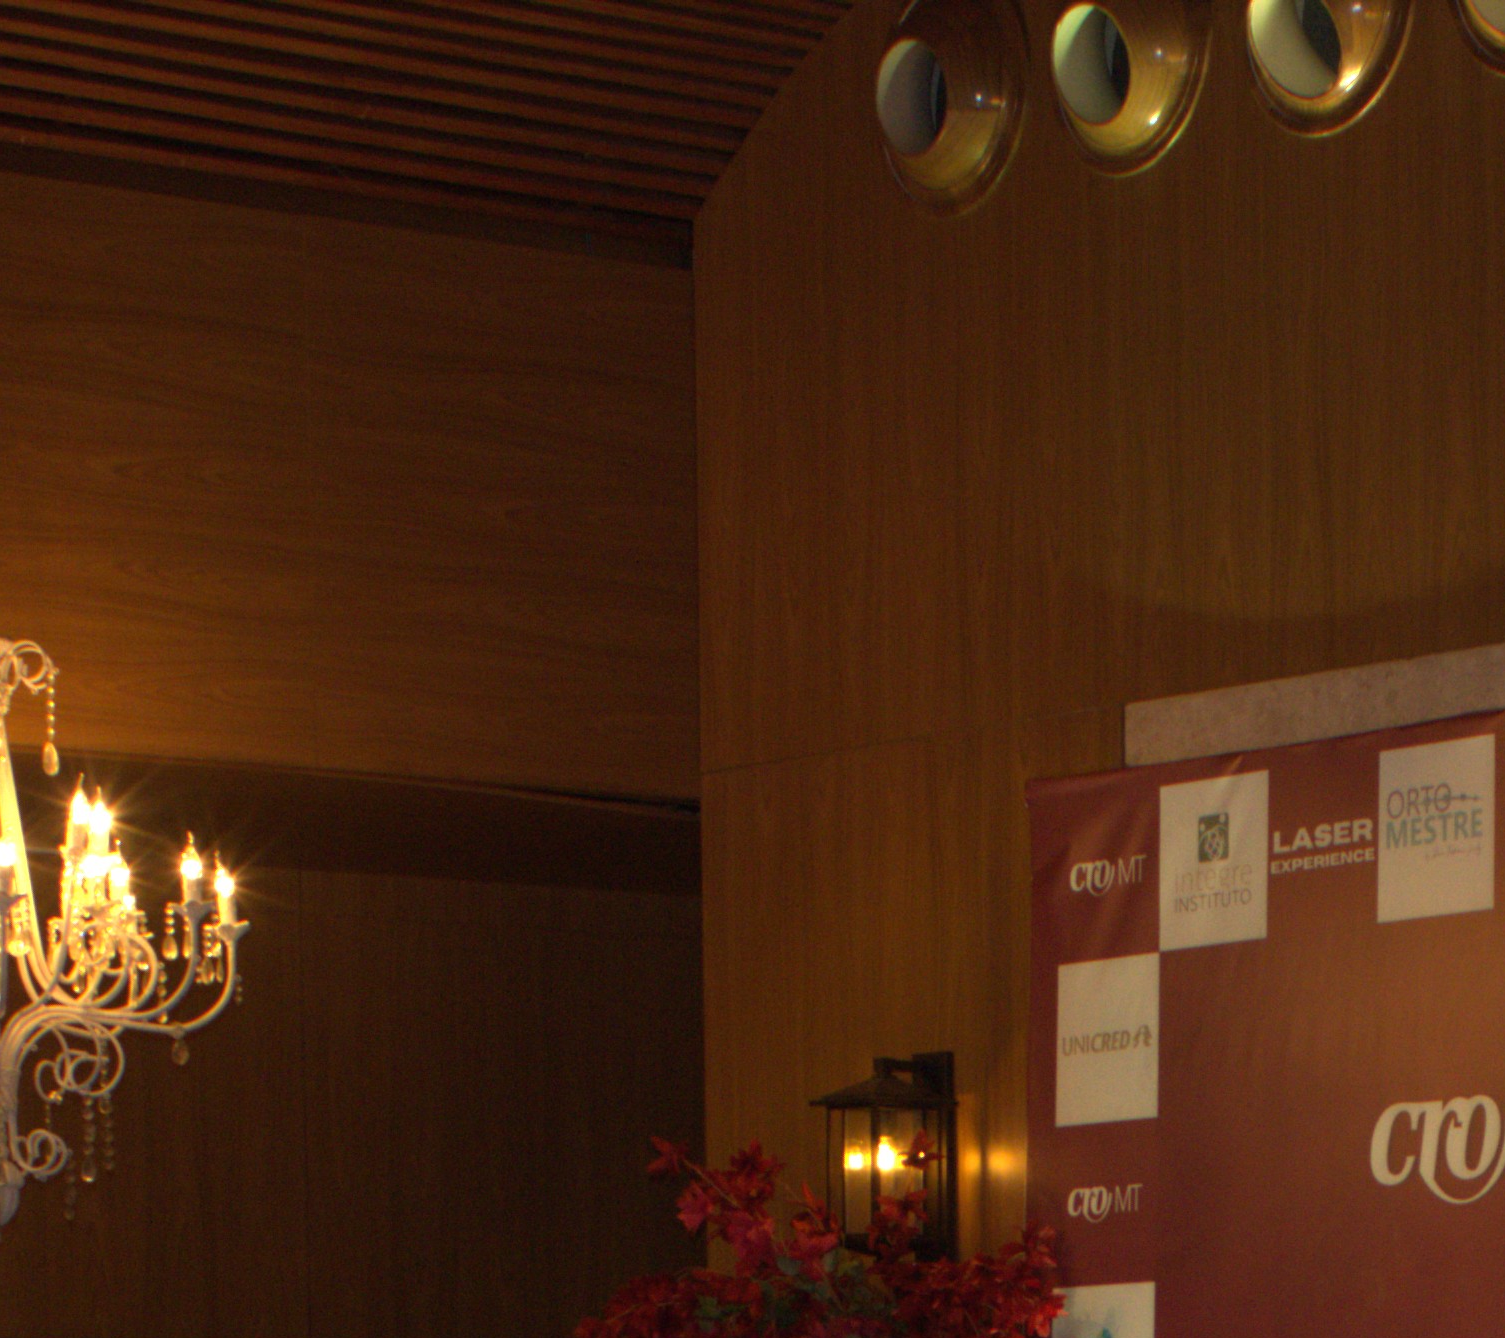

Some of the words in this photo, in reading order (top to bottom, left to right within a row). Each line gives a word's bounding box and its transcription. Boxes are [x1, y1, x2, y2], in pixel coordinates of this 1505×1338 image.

[1273, 818, 1373, 853] LASER
[1386, 808, 1484, 849] MESTRE
[1270, 847, 1375, 875] EXPERIENCE
[1174, 862, 1253, 893] integre
[1174, 889, 1252, 913] INSTITUTO
[1062, 1030, 1130, 1057] UNICRED
